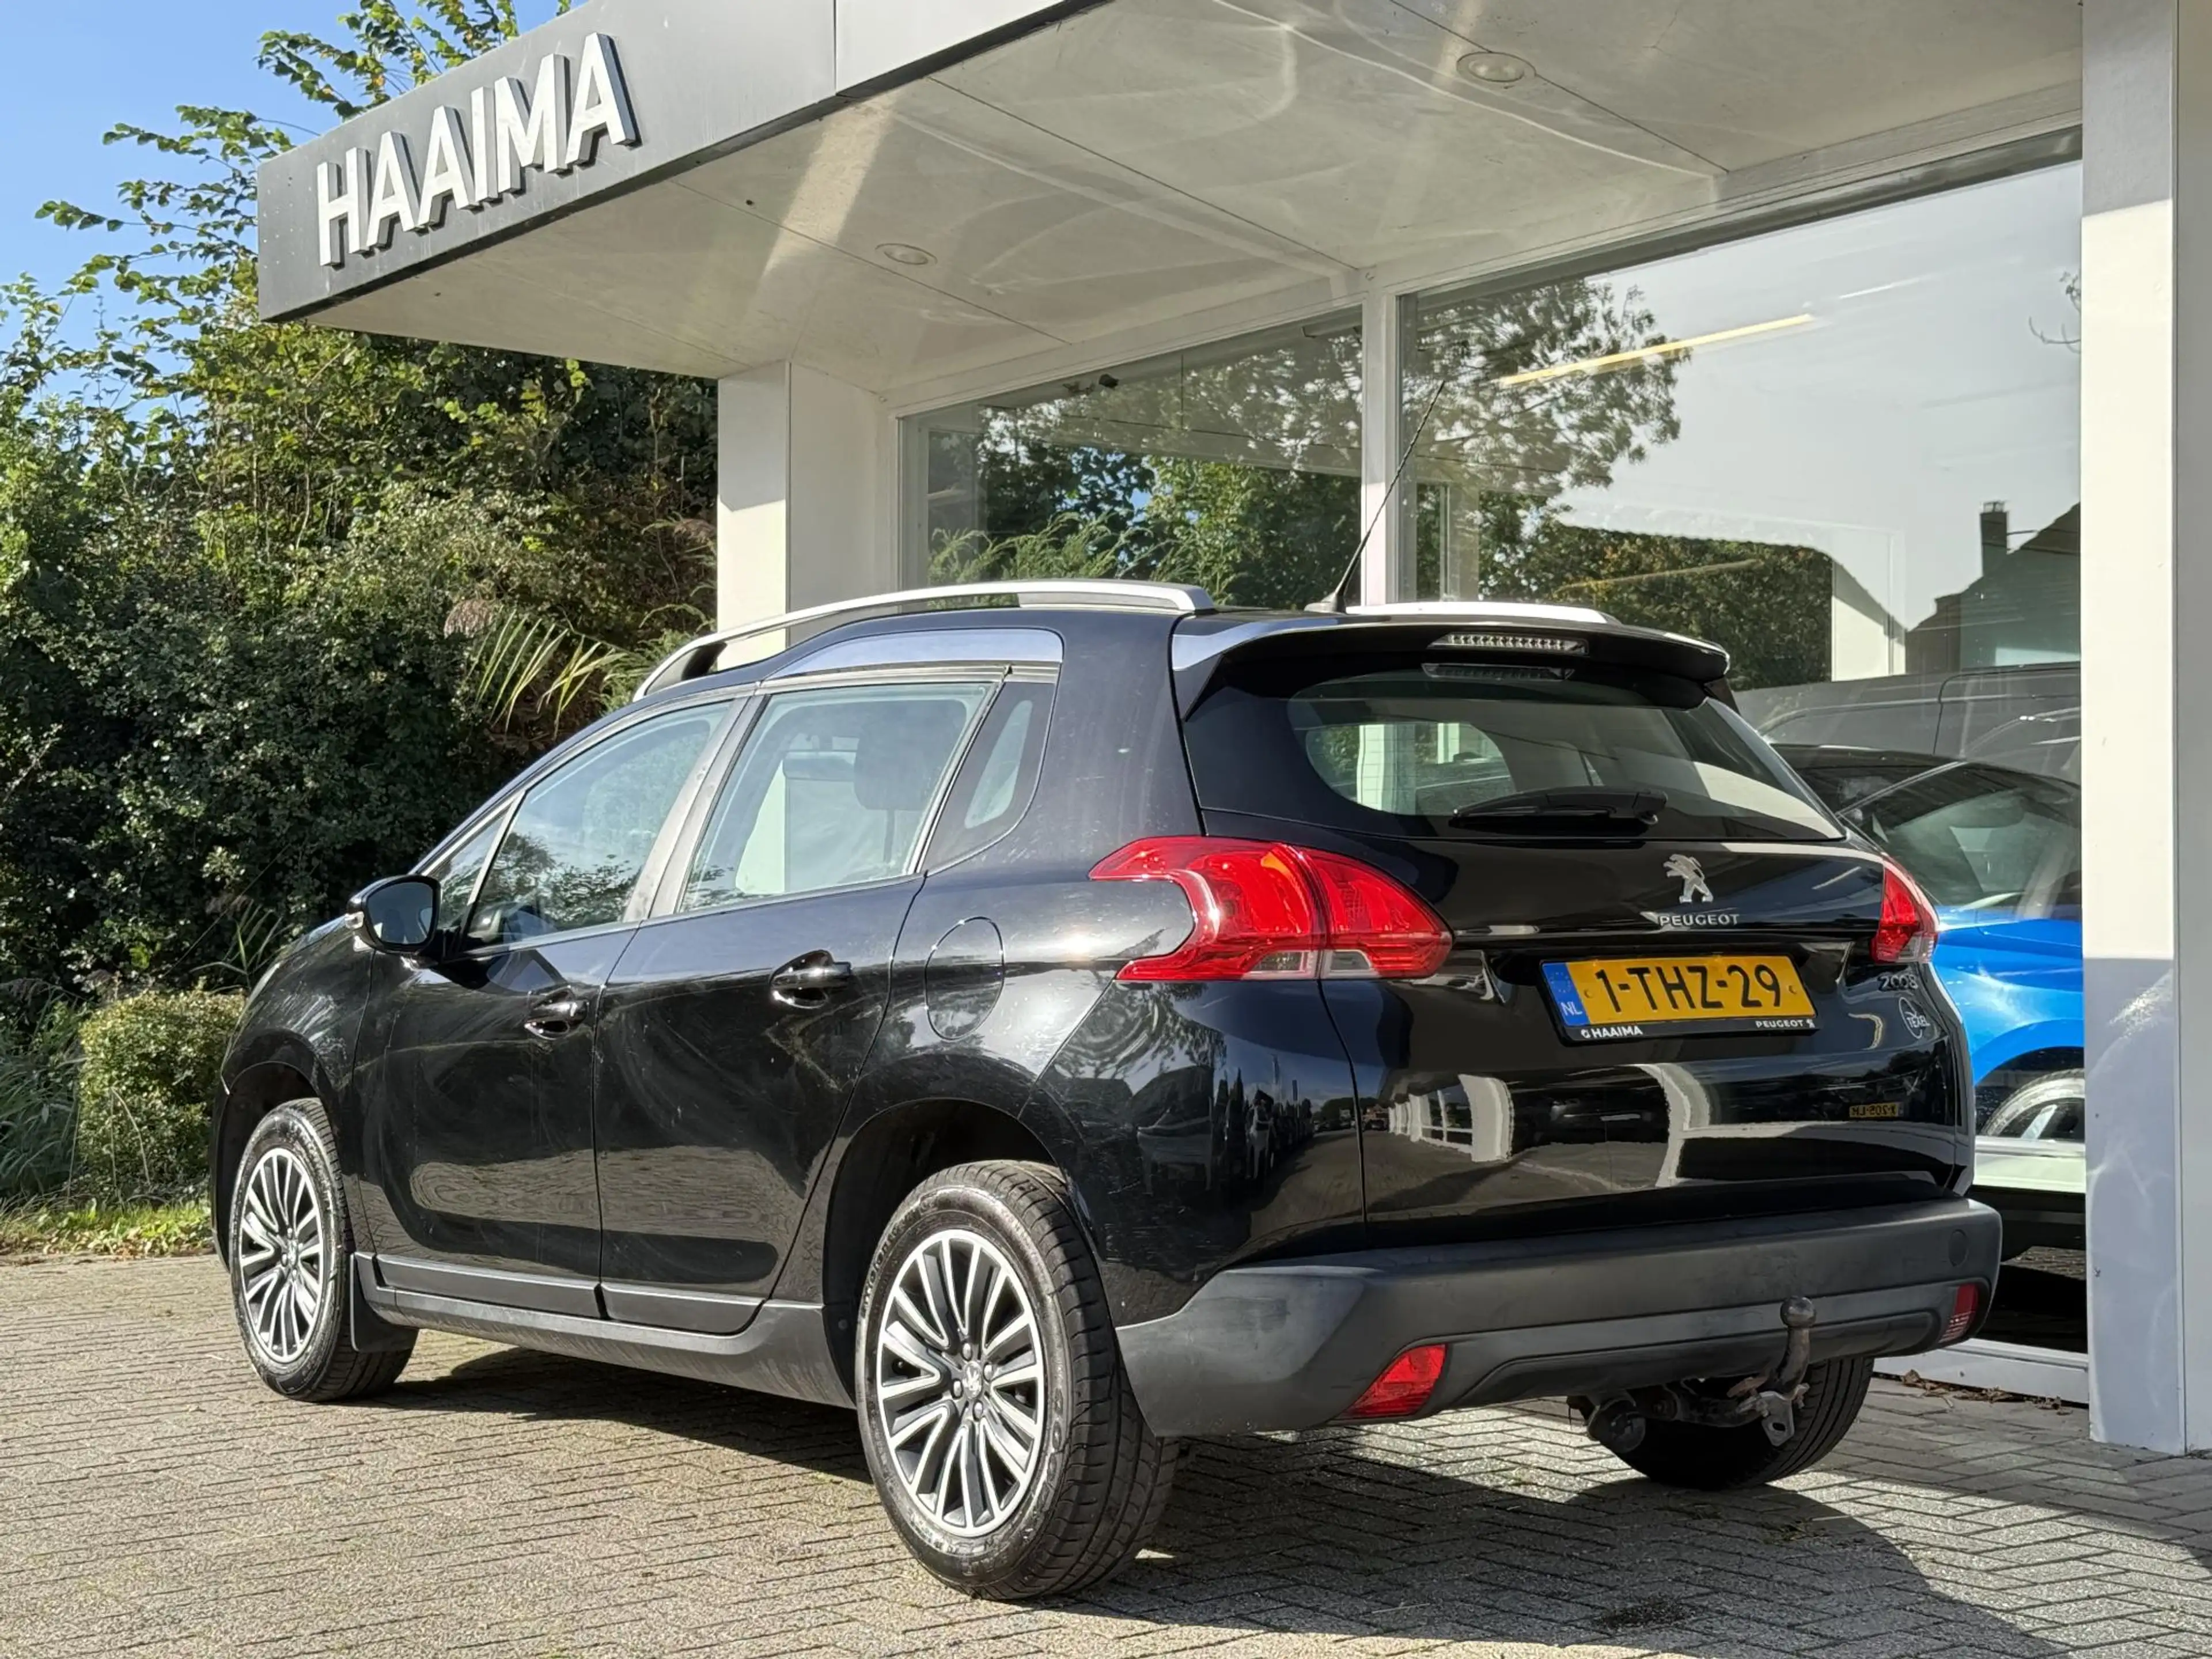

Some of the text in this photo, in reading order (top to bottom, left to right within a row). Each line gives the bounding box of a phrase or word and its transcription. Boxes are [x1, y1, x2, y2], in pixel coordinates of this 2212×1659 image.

[317, 32, 637, 267] HAAIMA
[1659, 913, 1740, 926] PEUGEOT
[1594, 964, 1781, 1013] 1-THZ-29
[1879, 974, 1919, 990] 2008
[1560, 1001, 1583, 1017] NL
[1755, 1019, 1804, 1028] PEUGEOT
[1590, 1025, 1643, 1039] HAAIMA
